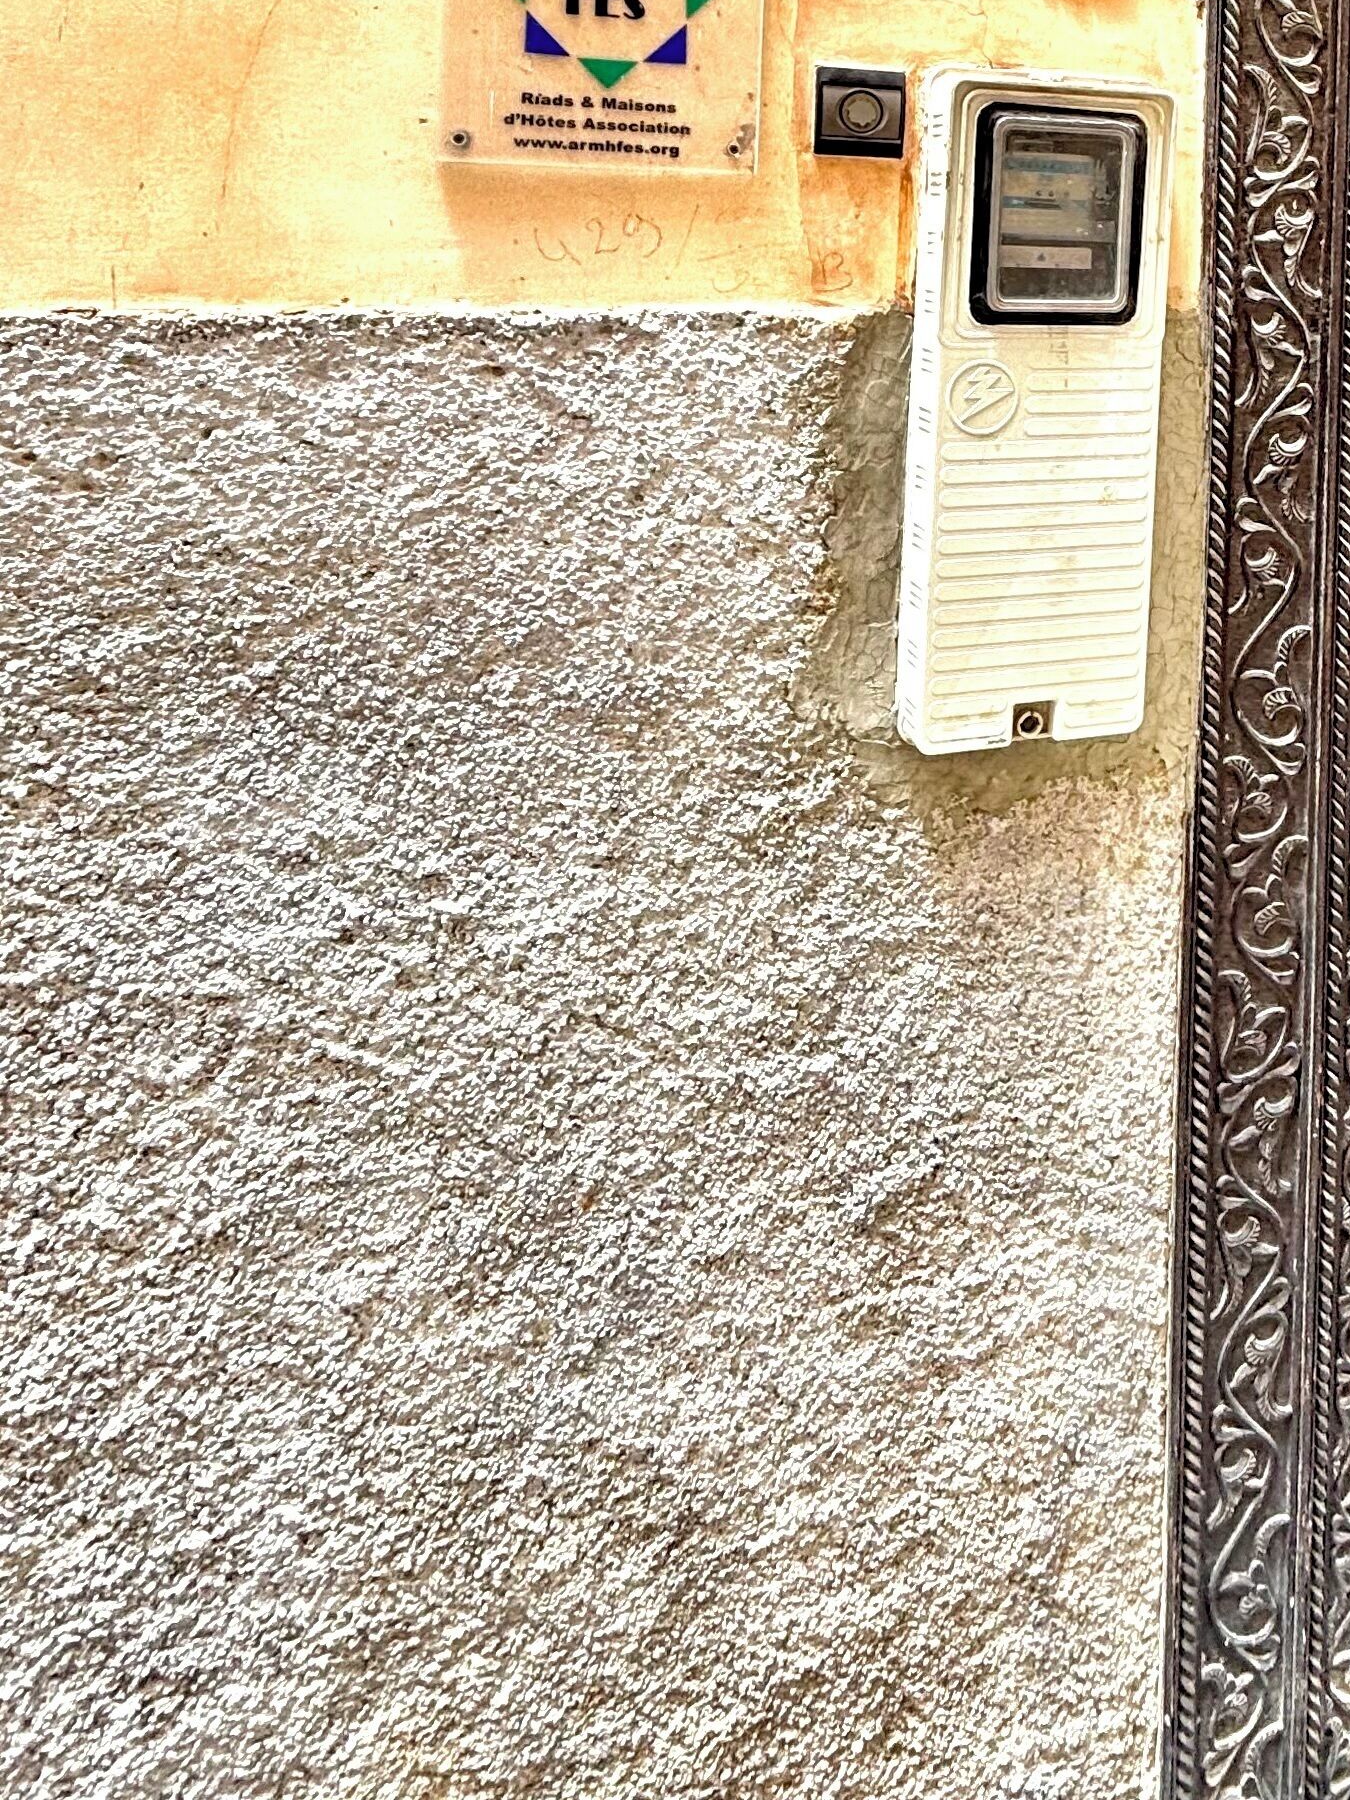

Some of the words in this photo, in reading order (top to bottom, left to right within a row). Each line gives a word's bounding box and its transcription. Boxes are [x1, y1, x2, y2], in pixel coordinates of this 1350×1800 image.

[521, 92, 574, 107] Riads
[581, 96, 594, 108] &
[601, 97, 677, 114] Maisons
[582, 117, 691, 136] Association
[513, 137, 680, 158] www.armhfes.org
